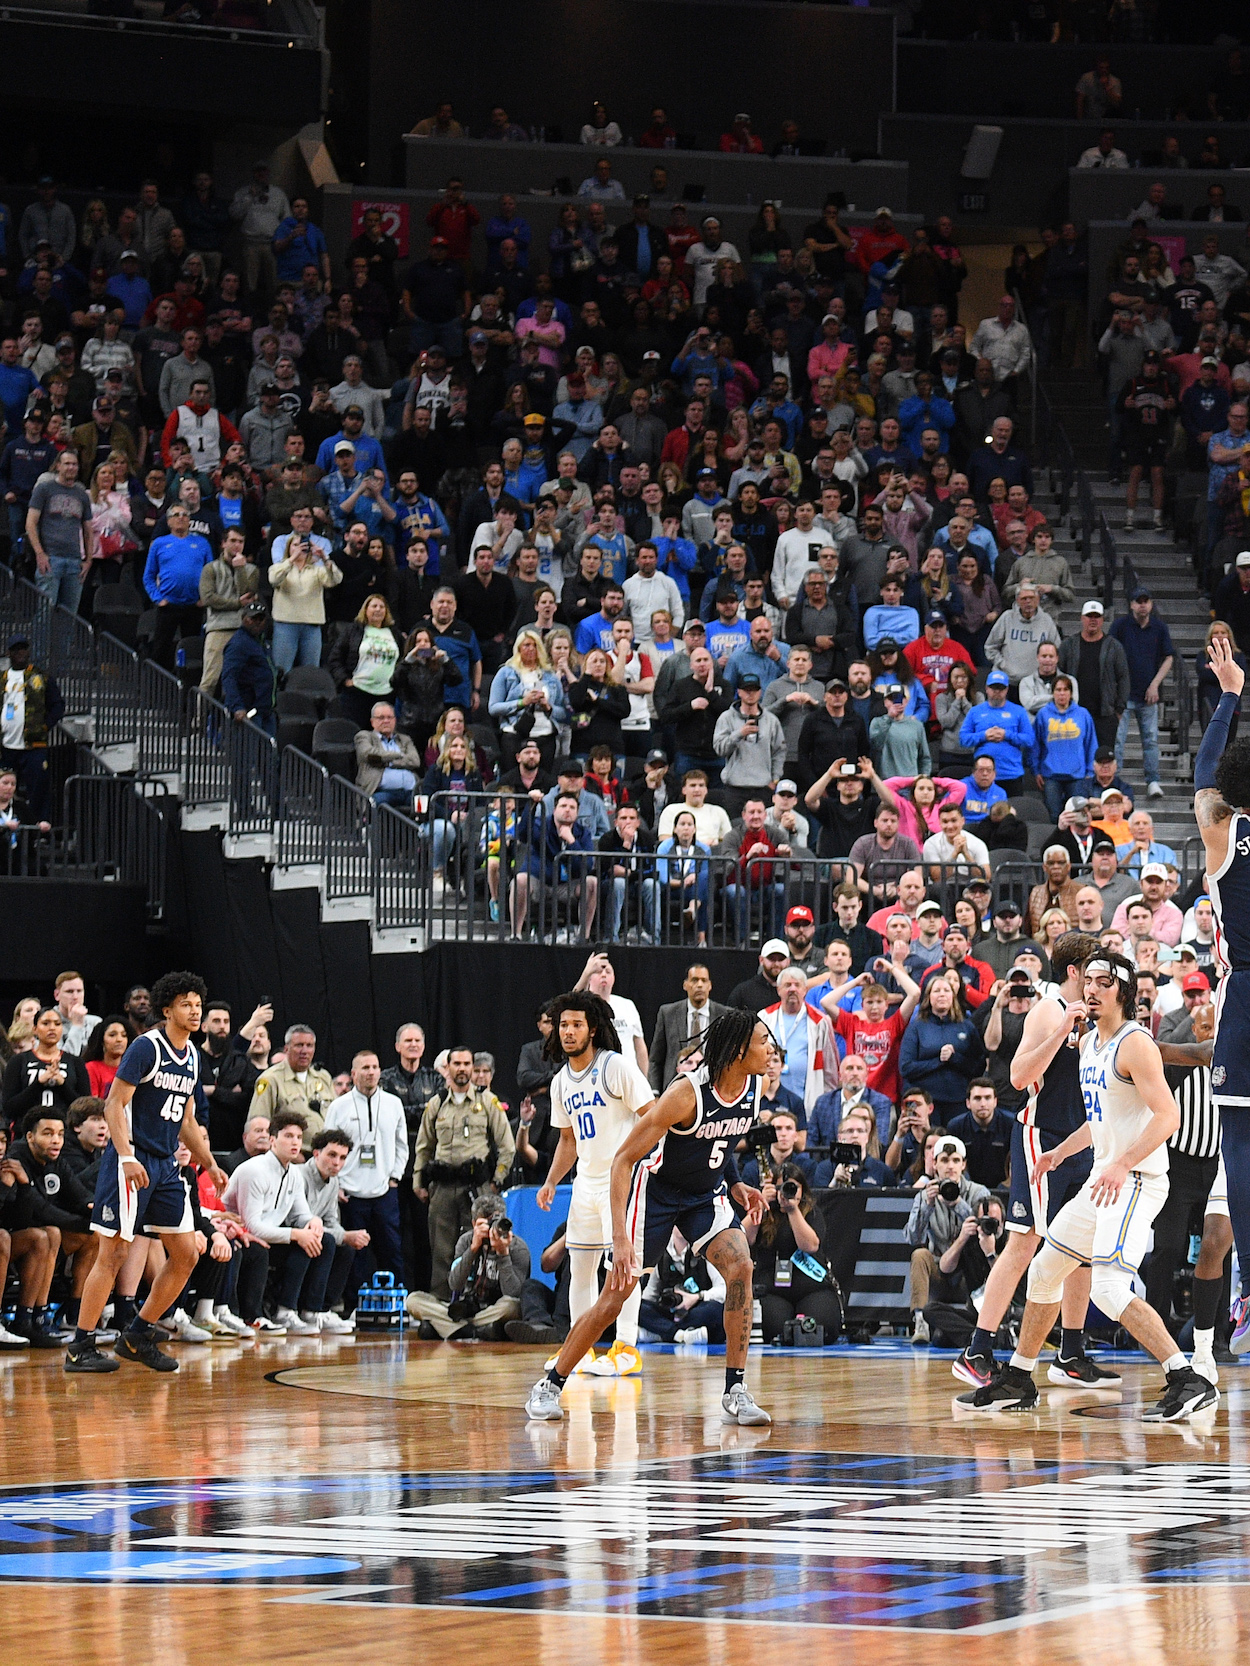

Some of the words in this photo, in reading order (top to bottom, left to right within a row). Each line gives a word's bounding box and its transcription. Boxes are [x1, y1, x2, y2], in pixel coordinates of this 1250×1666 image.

[198, 437, 206, 453] 1
[540, 559, 551, 575] 2
[602, 562, 614, 578] 2
[1010, 629, 1047, 643] UCLA
[922, 655, 953, 665] GONZAGA
[153, 1071, 196, 1096] GONZAG
[42, 1090, 54, 1107] 0
[160, 1094, 187, 1123] 45
[562, 1091, 607, 1116] UCLA
[1083, 1091, 1103, 1123] 24
[577, 1112, 597, 1141] 10
[708, 1140, 729, 1171] 5
[127, 1479, 940, 1560] MARCH
